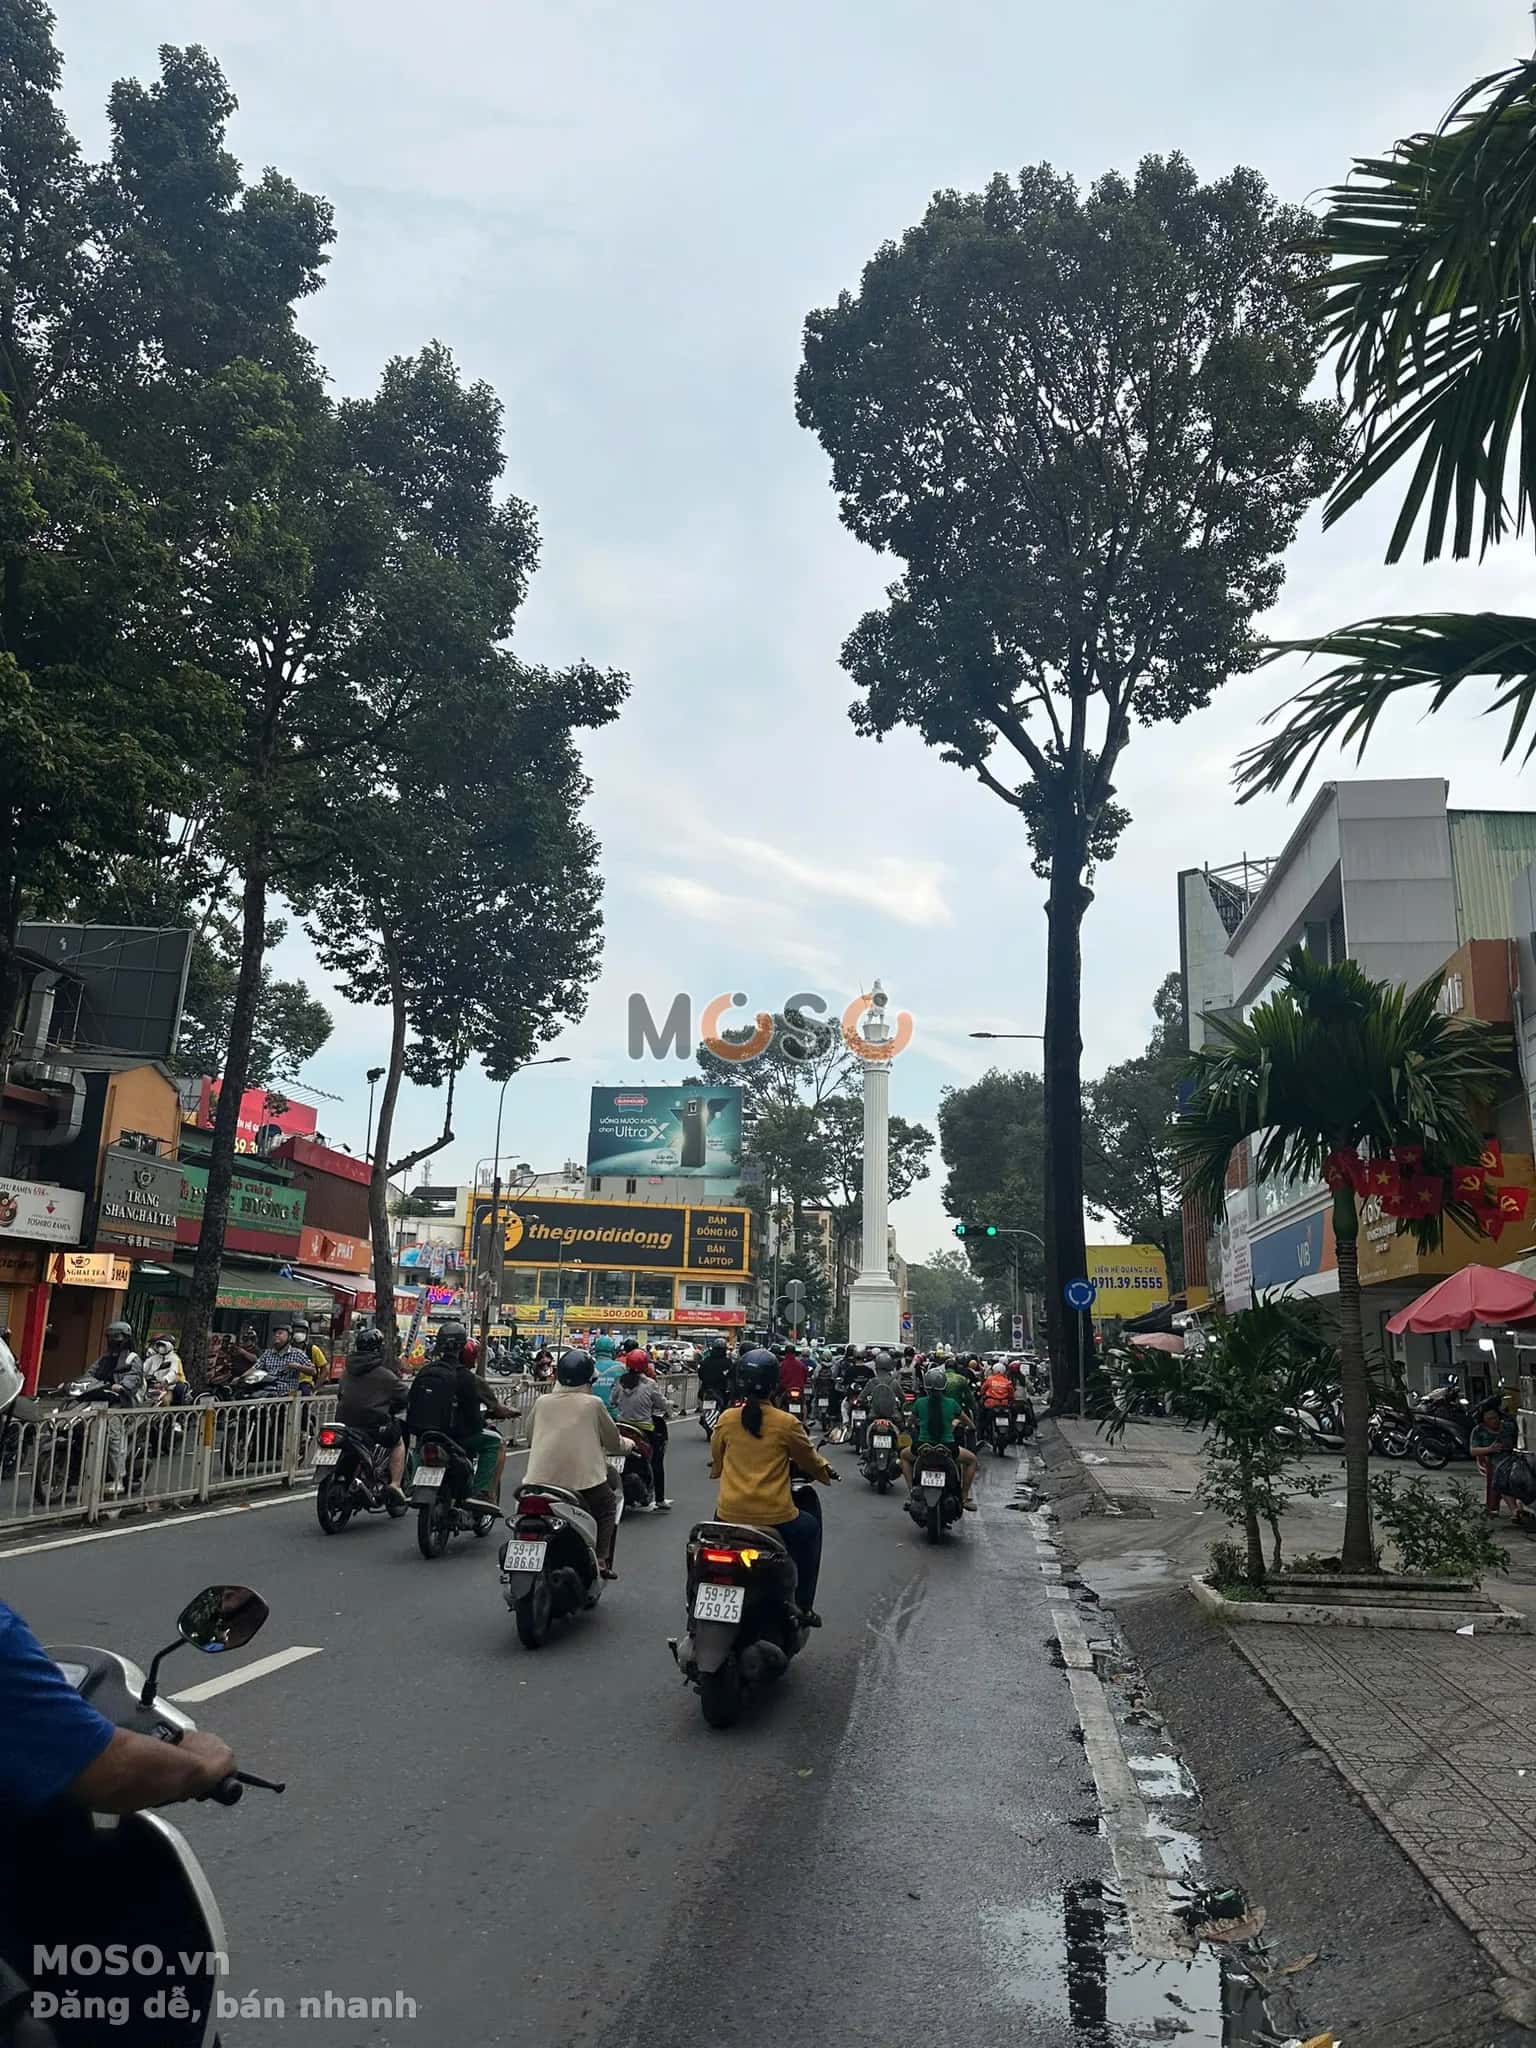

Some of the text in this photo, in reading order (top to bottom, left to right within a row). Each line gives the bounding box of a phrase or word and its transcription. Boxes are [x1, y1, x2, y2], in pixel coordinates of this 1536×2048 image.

[127, 1190, 160, 1207] TRANG
[104, 1202, 177, 1227] SHANGHAI TEA
[528, 1223, 673, 1250] thegioididong
[698, 1256, 734, 1267] LAPTOP
[1296, 1241, 1311, 1268] VIB
[1091, 1277, 1163, 1289] 0911.39.5555
